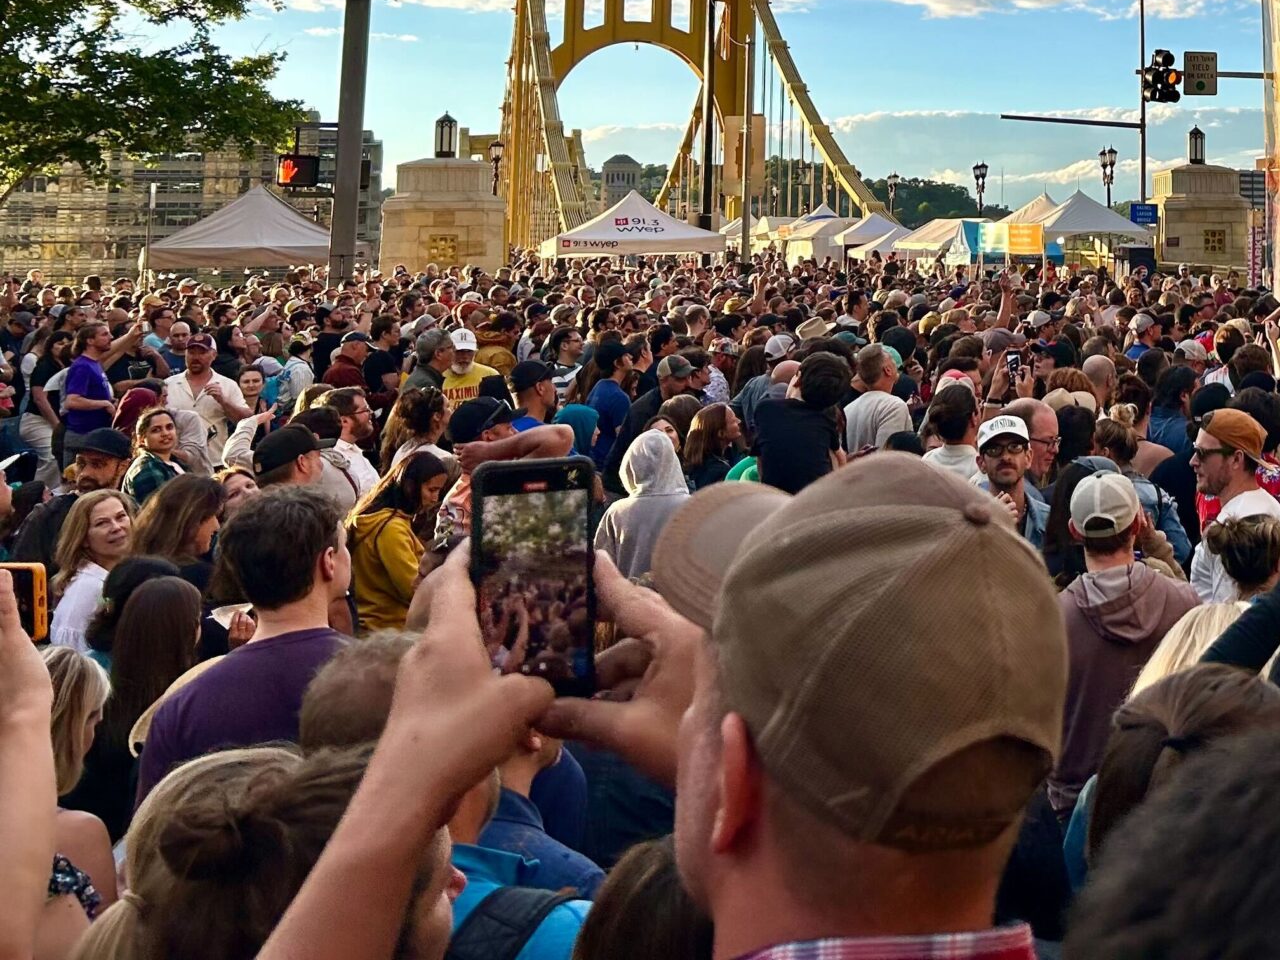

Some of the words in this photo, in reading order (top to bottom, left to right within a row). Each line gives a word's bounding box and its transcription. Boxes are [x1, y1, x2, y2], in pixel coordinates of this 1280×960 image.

[1191, 63, 1210, 72] YIELD
[1187, 72, 1196, 80] ON
[1197, 72, 1214, 80] GREEN
[631, 218, 660, 226] 91.3
[590, 240, 619, 249] wyep
[1255, 226, 1263, 274] MARKET
